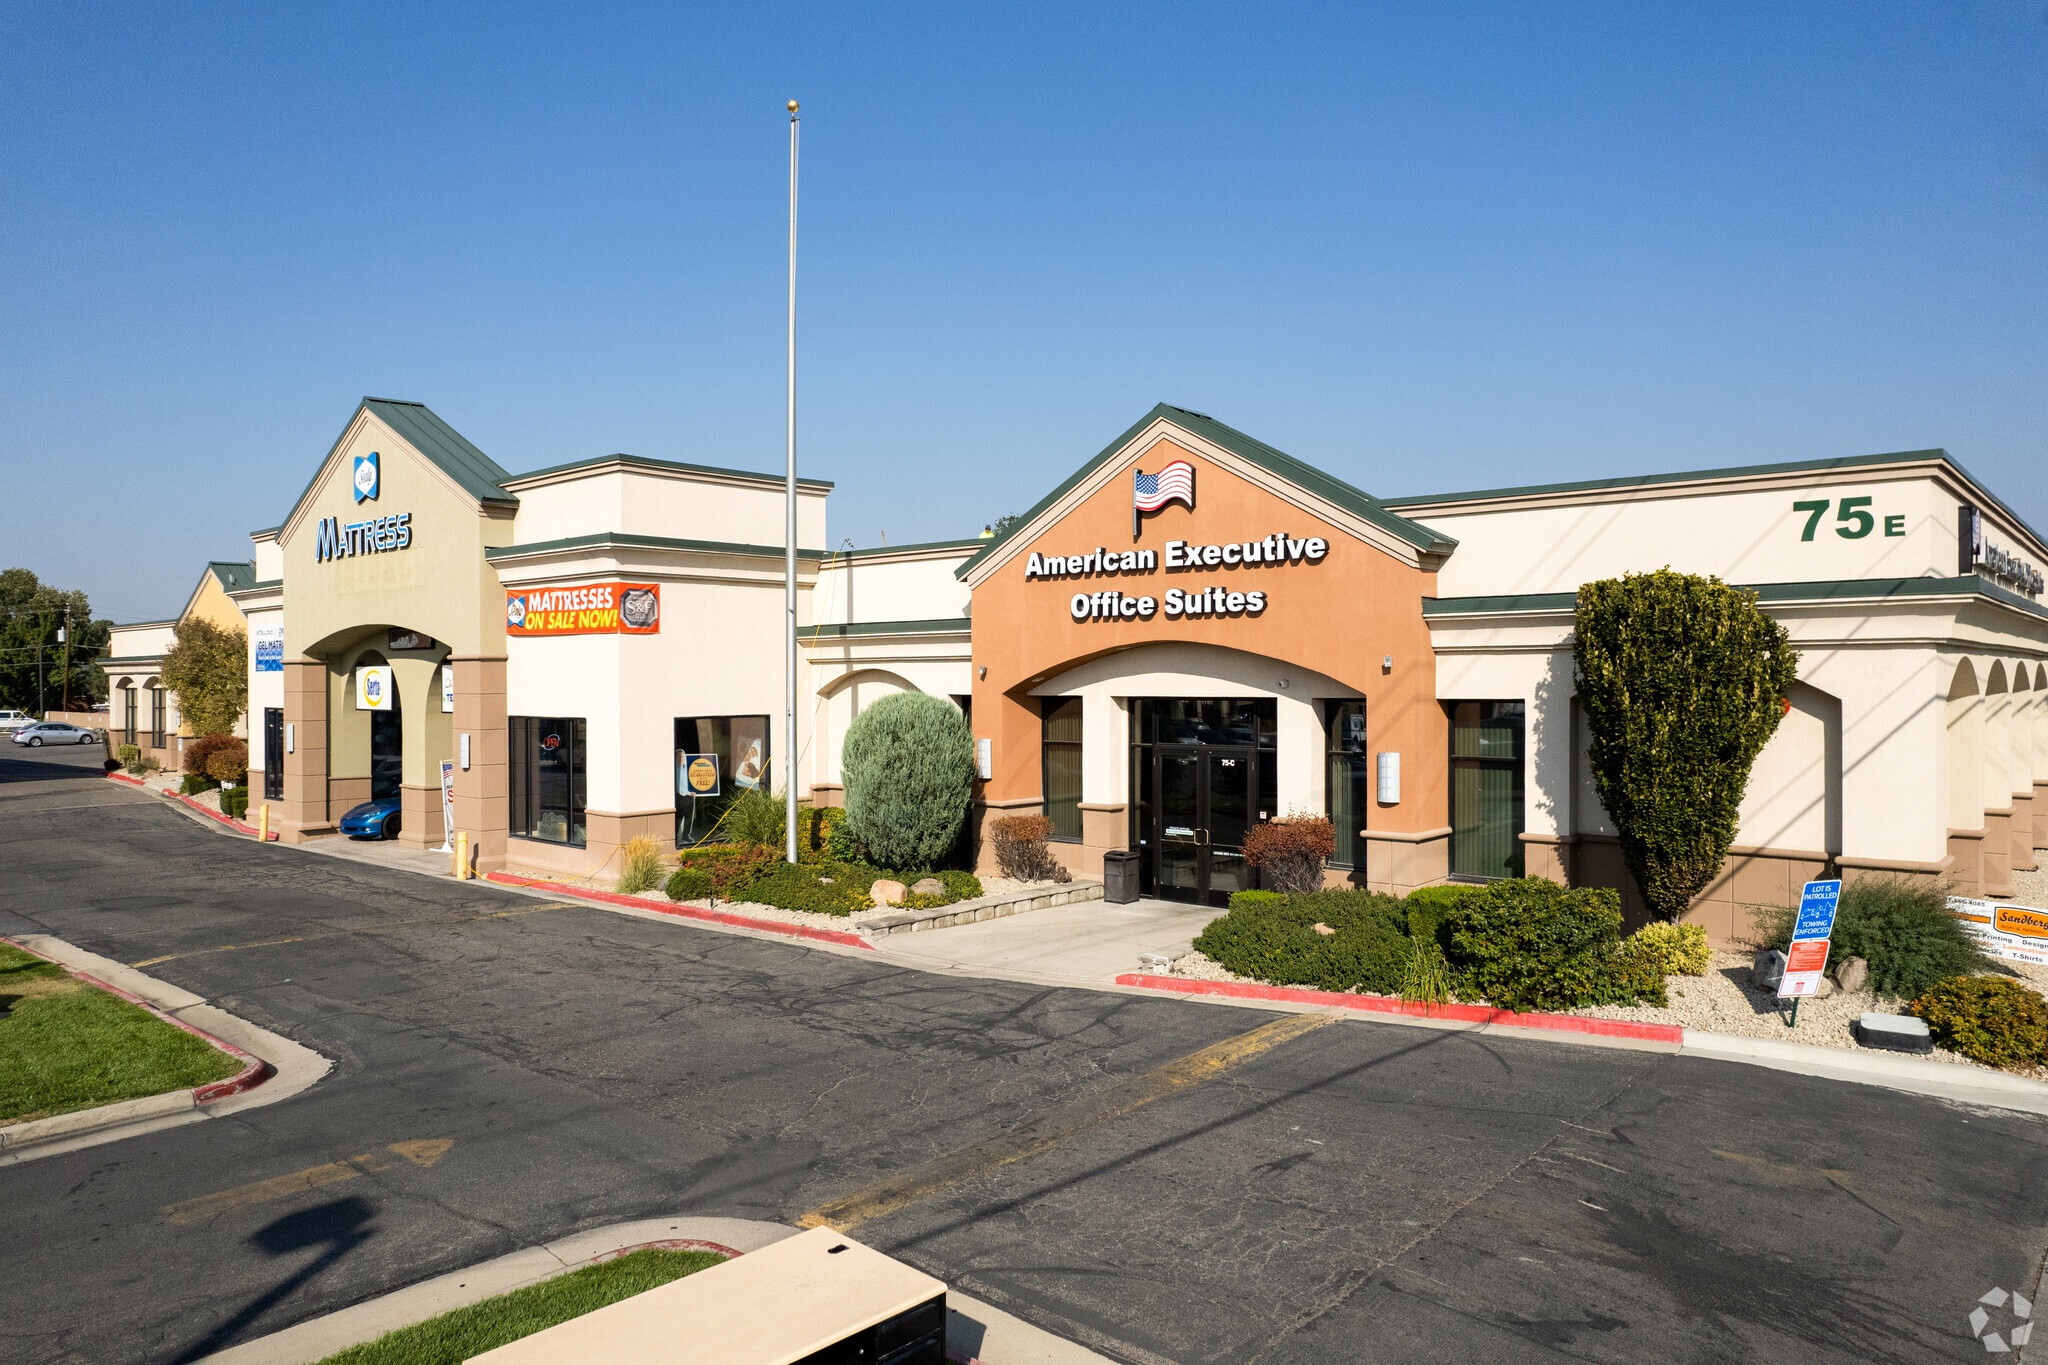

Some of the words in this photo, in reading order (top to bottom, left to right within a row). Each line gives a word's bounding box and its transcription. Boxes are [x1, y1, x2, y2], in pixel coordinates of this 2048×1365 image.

[1793, 496, 1875, 542] 75
[1884, 514, 1906, 538] E
[315, 513, 411, 562] MATTRESS
[1024, 547, 1156, 579] American
[1165, 533, 1328, 569] Executive
[528, 587, 614, 612] MATTRESSES
[1070, 591, 1156, 620] Office
[1164, 587, 1266, 617] Suites
[525, 611, 544, 630] ON
[547, 611, 575, 629] SALE
[578, 609, 619, 628] NOW!
[366, 678, 381, 696] Serta
[543, 737, 560, 748] OPEN
[1804, 892, 1837, 900] PATROLLED
[1802, 920, 1828, 928] TOWING
[2000, 912, 2048, 930] Sandberg
[1795, 927, 1830, 936] ENFORCED
[1983, 933, 2013, 944] Printing
[2003, 944, 2047, 956] Lamination
[2012, 952, 2043, 962] T-Shirts
